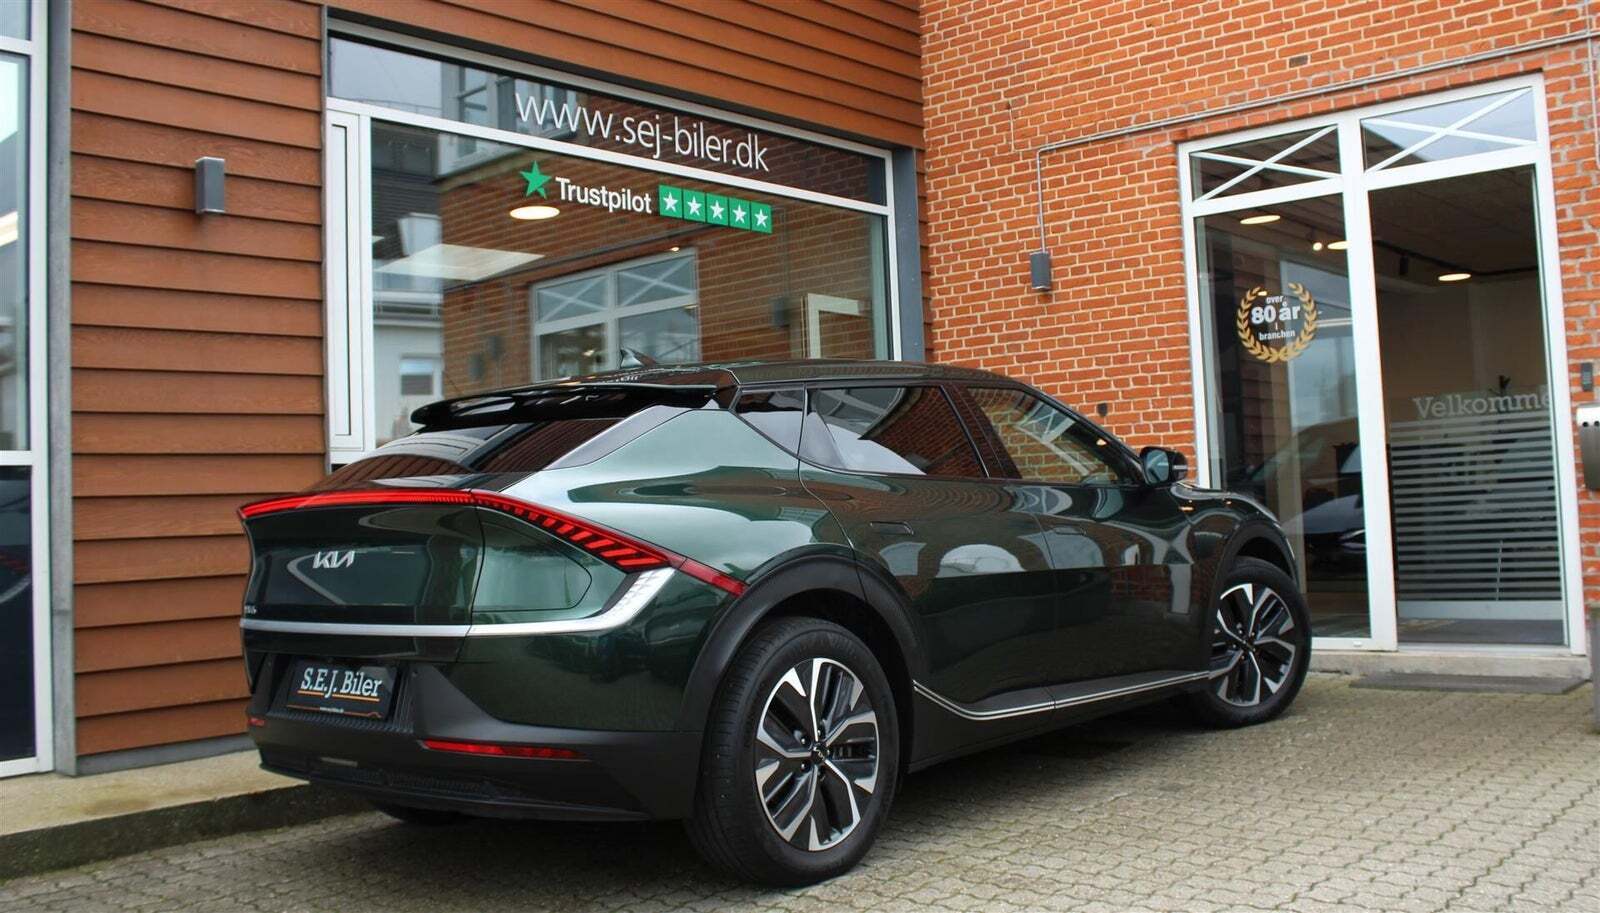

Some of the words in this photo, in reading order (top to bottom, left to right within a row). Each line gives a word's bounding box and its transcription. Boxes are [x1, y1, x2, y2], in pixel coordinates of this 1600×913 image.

[516, 94, 769, 172] www.sej-biler.dk
[556, 176, 652, 214] Trustpilot
[1266, 295, 1284, 304] over
[1251, 305, 1276, 325] 80
[1279, 302, 1301, 321] år
[1259, 330, 1296, 341] branchen
[301, 667, 337, 698] S.E.J.
[340, 670, 383, 697] Biler
